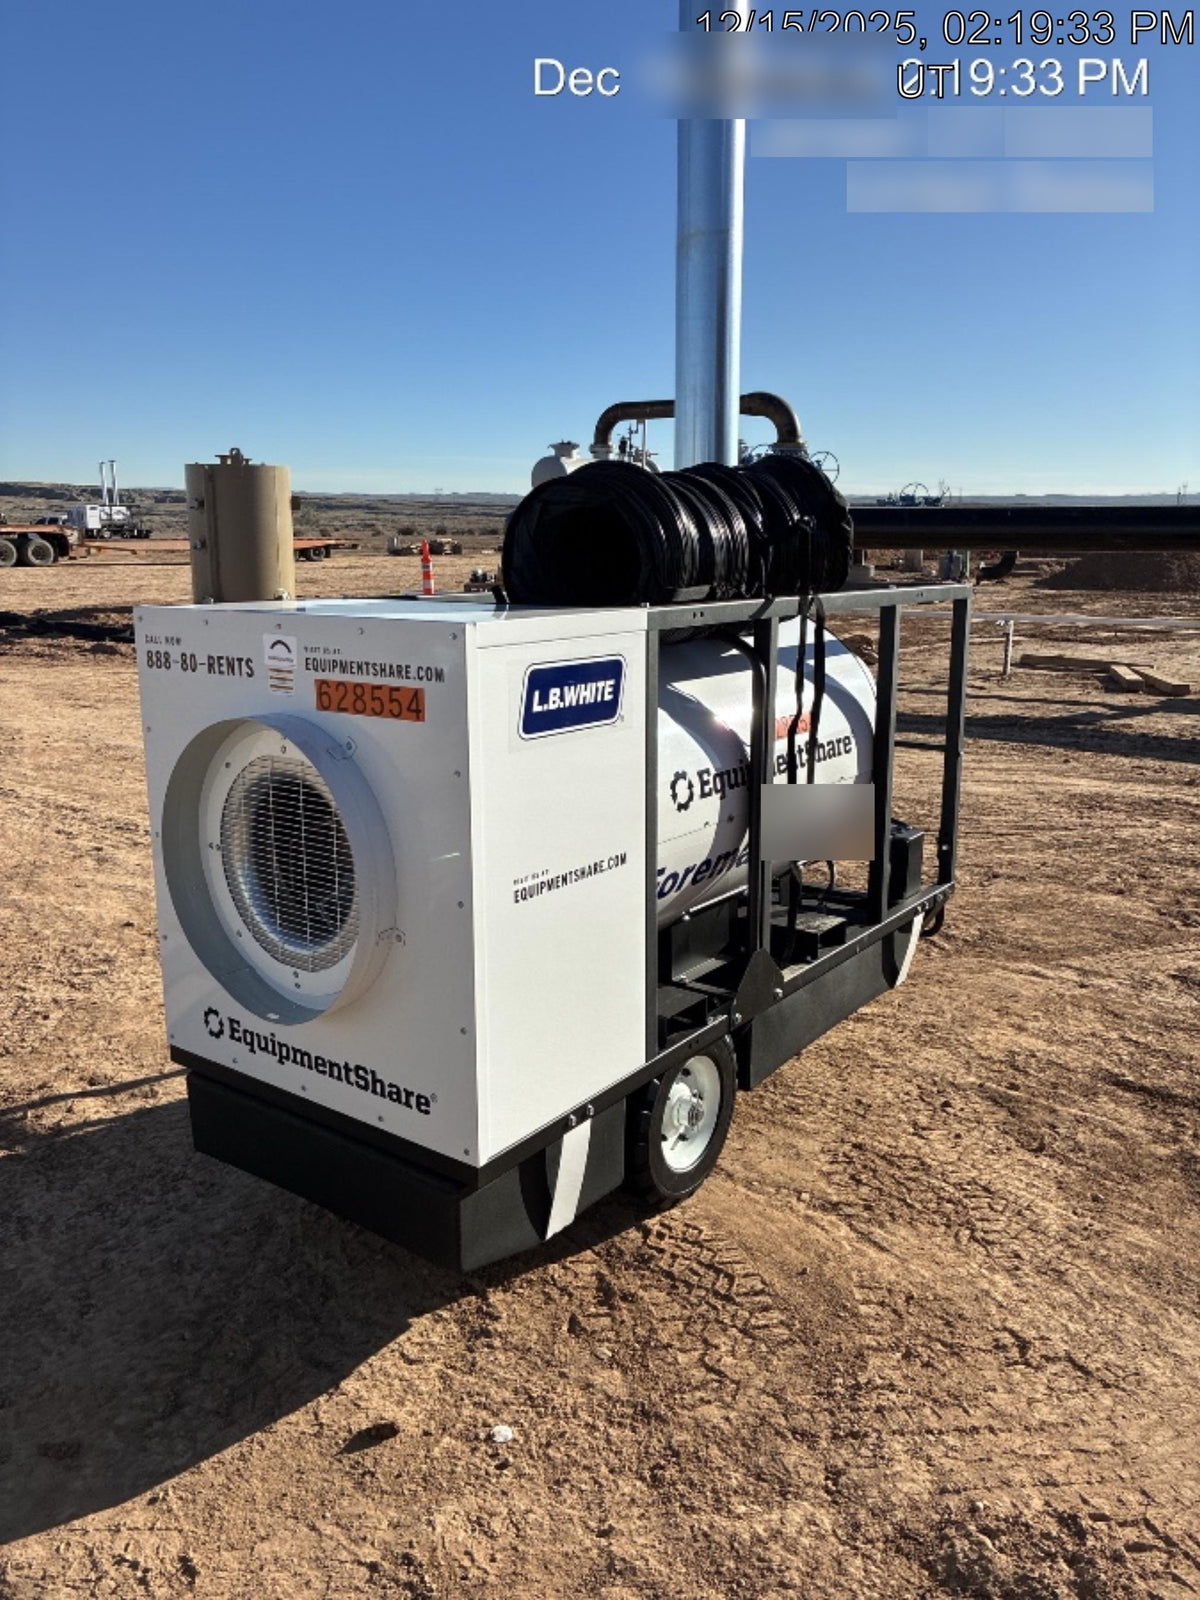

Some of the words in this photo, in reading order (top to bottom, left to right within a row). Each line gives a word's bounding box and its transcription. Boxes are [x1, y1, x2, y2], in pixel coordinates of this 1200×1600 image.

[146, 650, 255, 678] 888-80-RENTS
[305, 657, 445, 683] EQUIPMENTSHARE.COM
[318, 680, 423, 720] 628554
[514, 852, 627, 904] EQUIPMENTSHARE.COM
